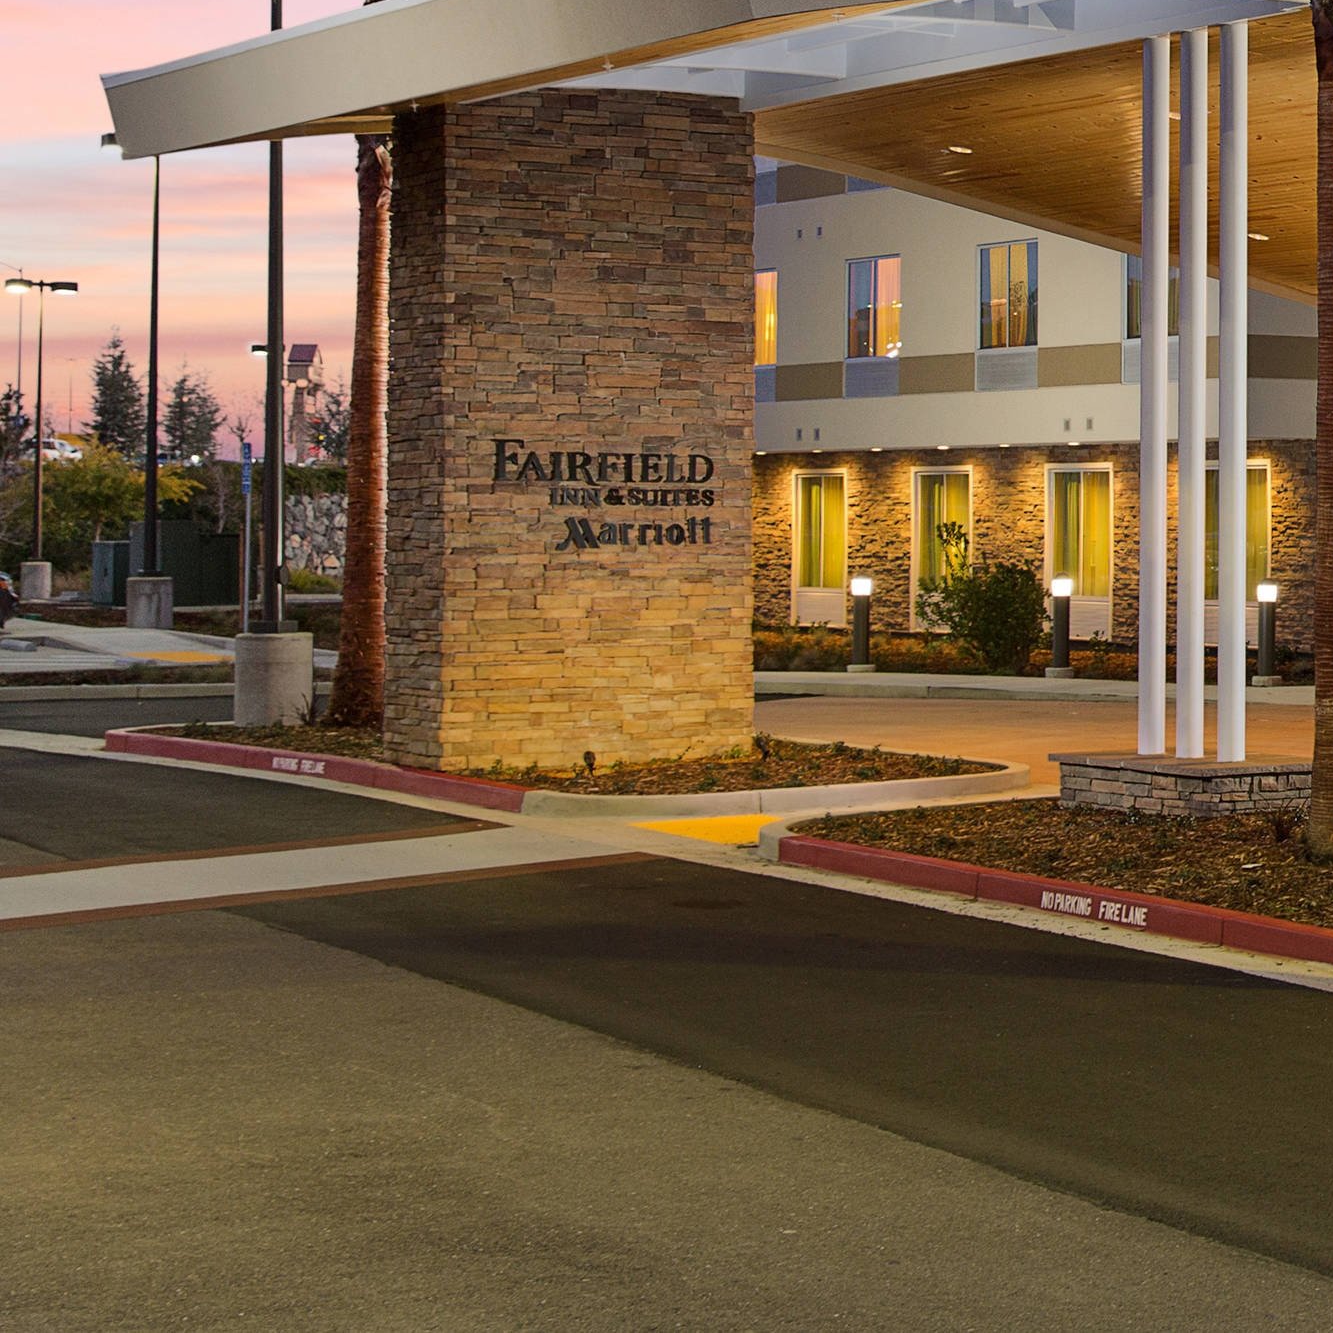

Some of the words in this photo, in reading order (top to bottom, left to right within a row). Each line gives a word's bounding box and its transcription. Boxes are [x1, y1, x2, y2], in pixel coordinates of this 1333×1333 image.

[491, 438, 714, 485] FAIRFIELD
[550, 487, 600, 506] INN
[603, 489, 626, 505] &
[627, 489, 714, 506] SUITES
[555, 516, 713, 550] Marriott
[1041, 891, 1053, 909] NO
[1054, 893, 1091, 915] PARKING
[1098, 901, 1121, 921] FIRE
[1121, 905, 1148, 925] LANE
